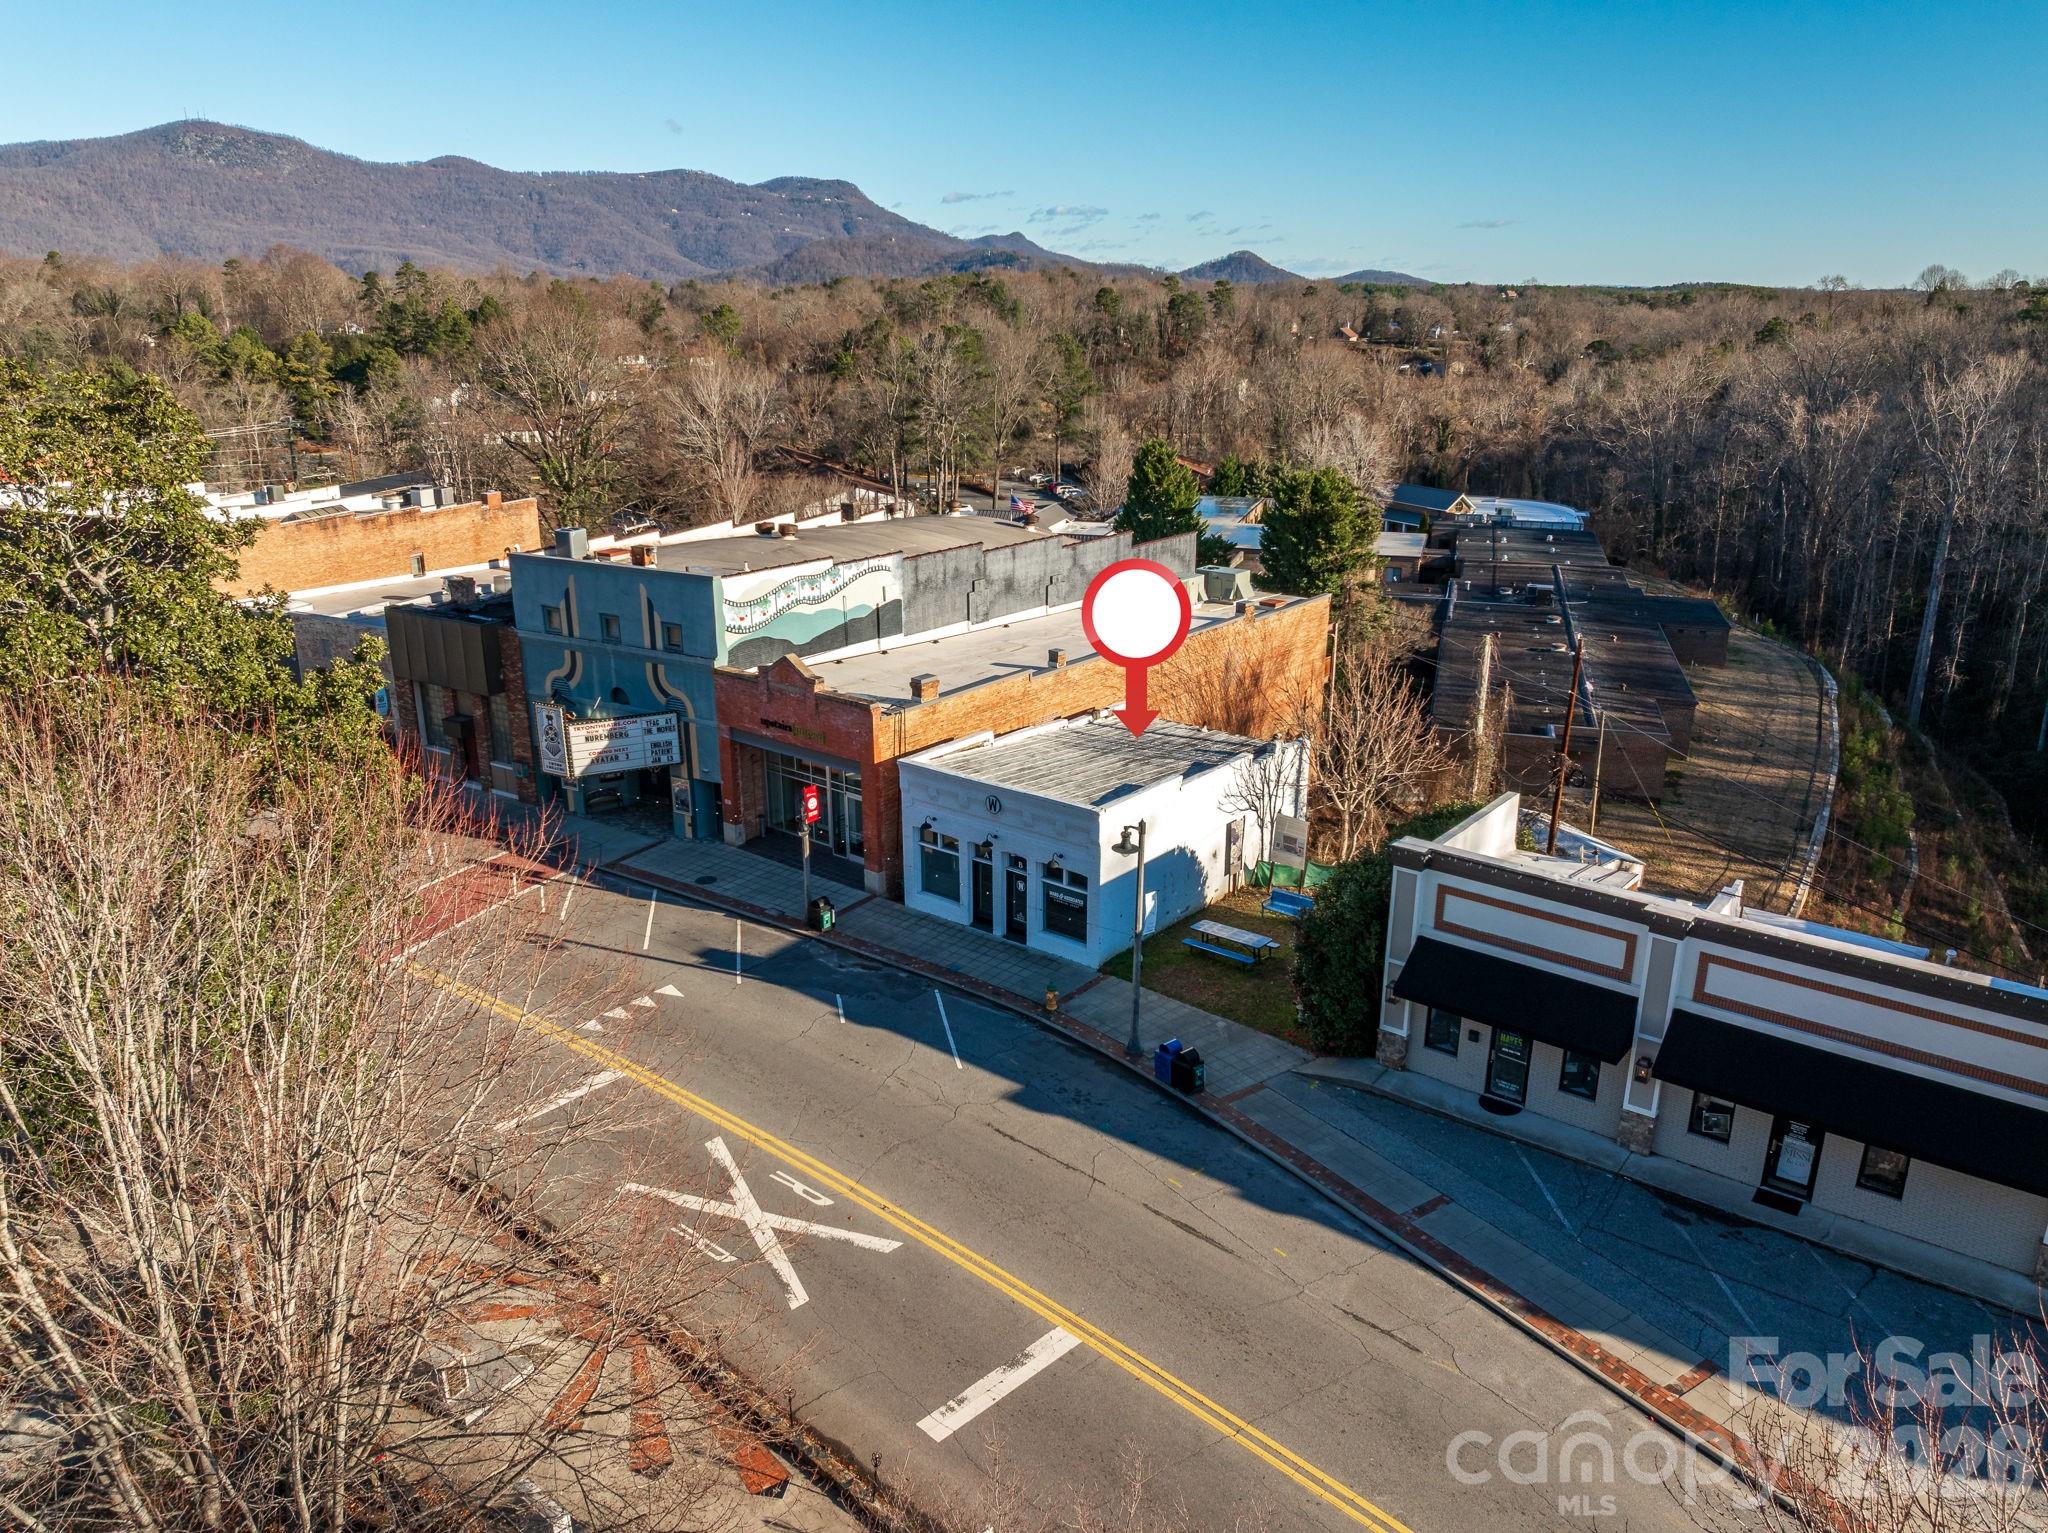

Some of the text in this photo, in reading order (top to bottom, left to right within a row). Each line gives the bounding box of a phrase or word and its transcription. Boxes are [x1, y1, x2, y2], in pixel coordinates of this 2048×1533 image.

[573, 719, 638, 732] TRYONTHEATRE.COM
[643, 725, 676, 735] THE MOVIES
[584, 731, 629, 742] NUREMBERG
[650, 740, 673, 749] ENGLISH
[651, 748, 673, 756] PATIENT
[591, 755, 619, 765] AVATAR
[652, 756, 661, 764] JAN
[983, 851, 990, 859] A
[1500, 1033, 1523, 1047] HAYES
